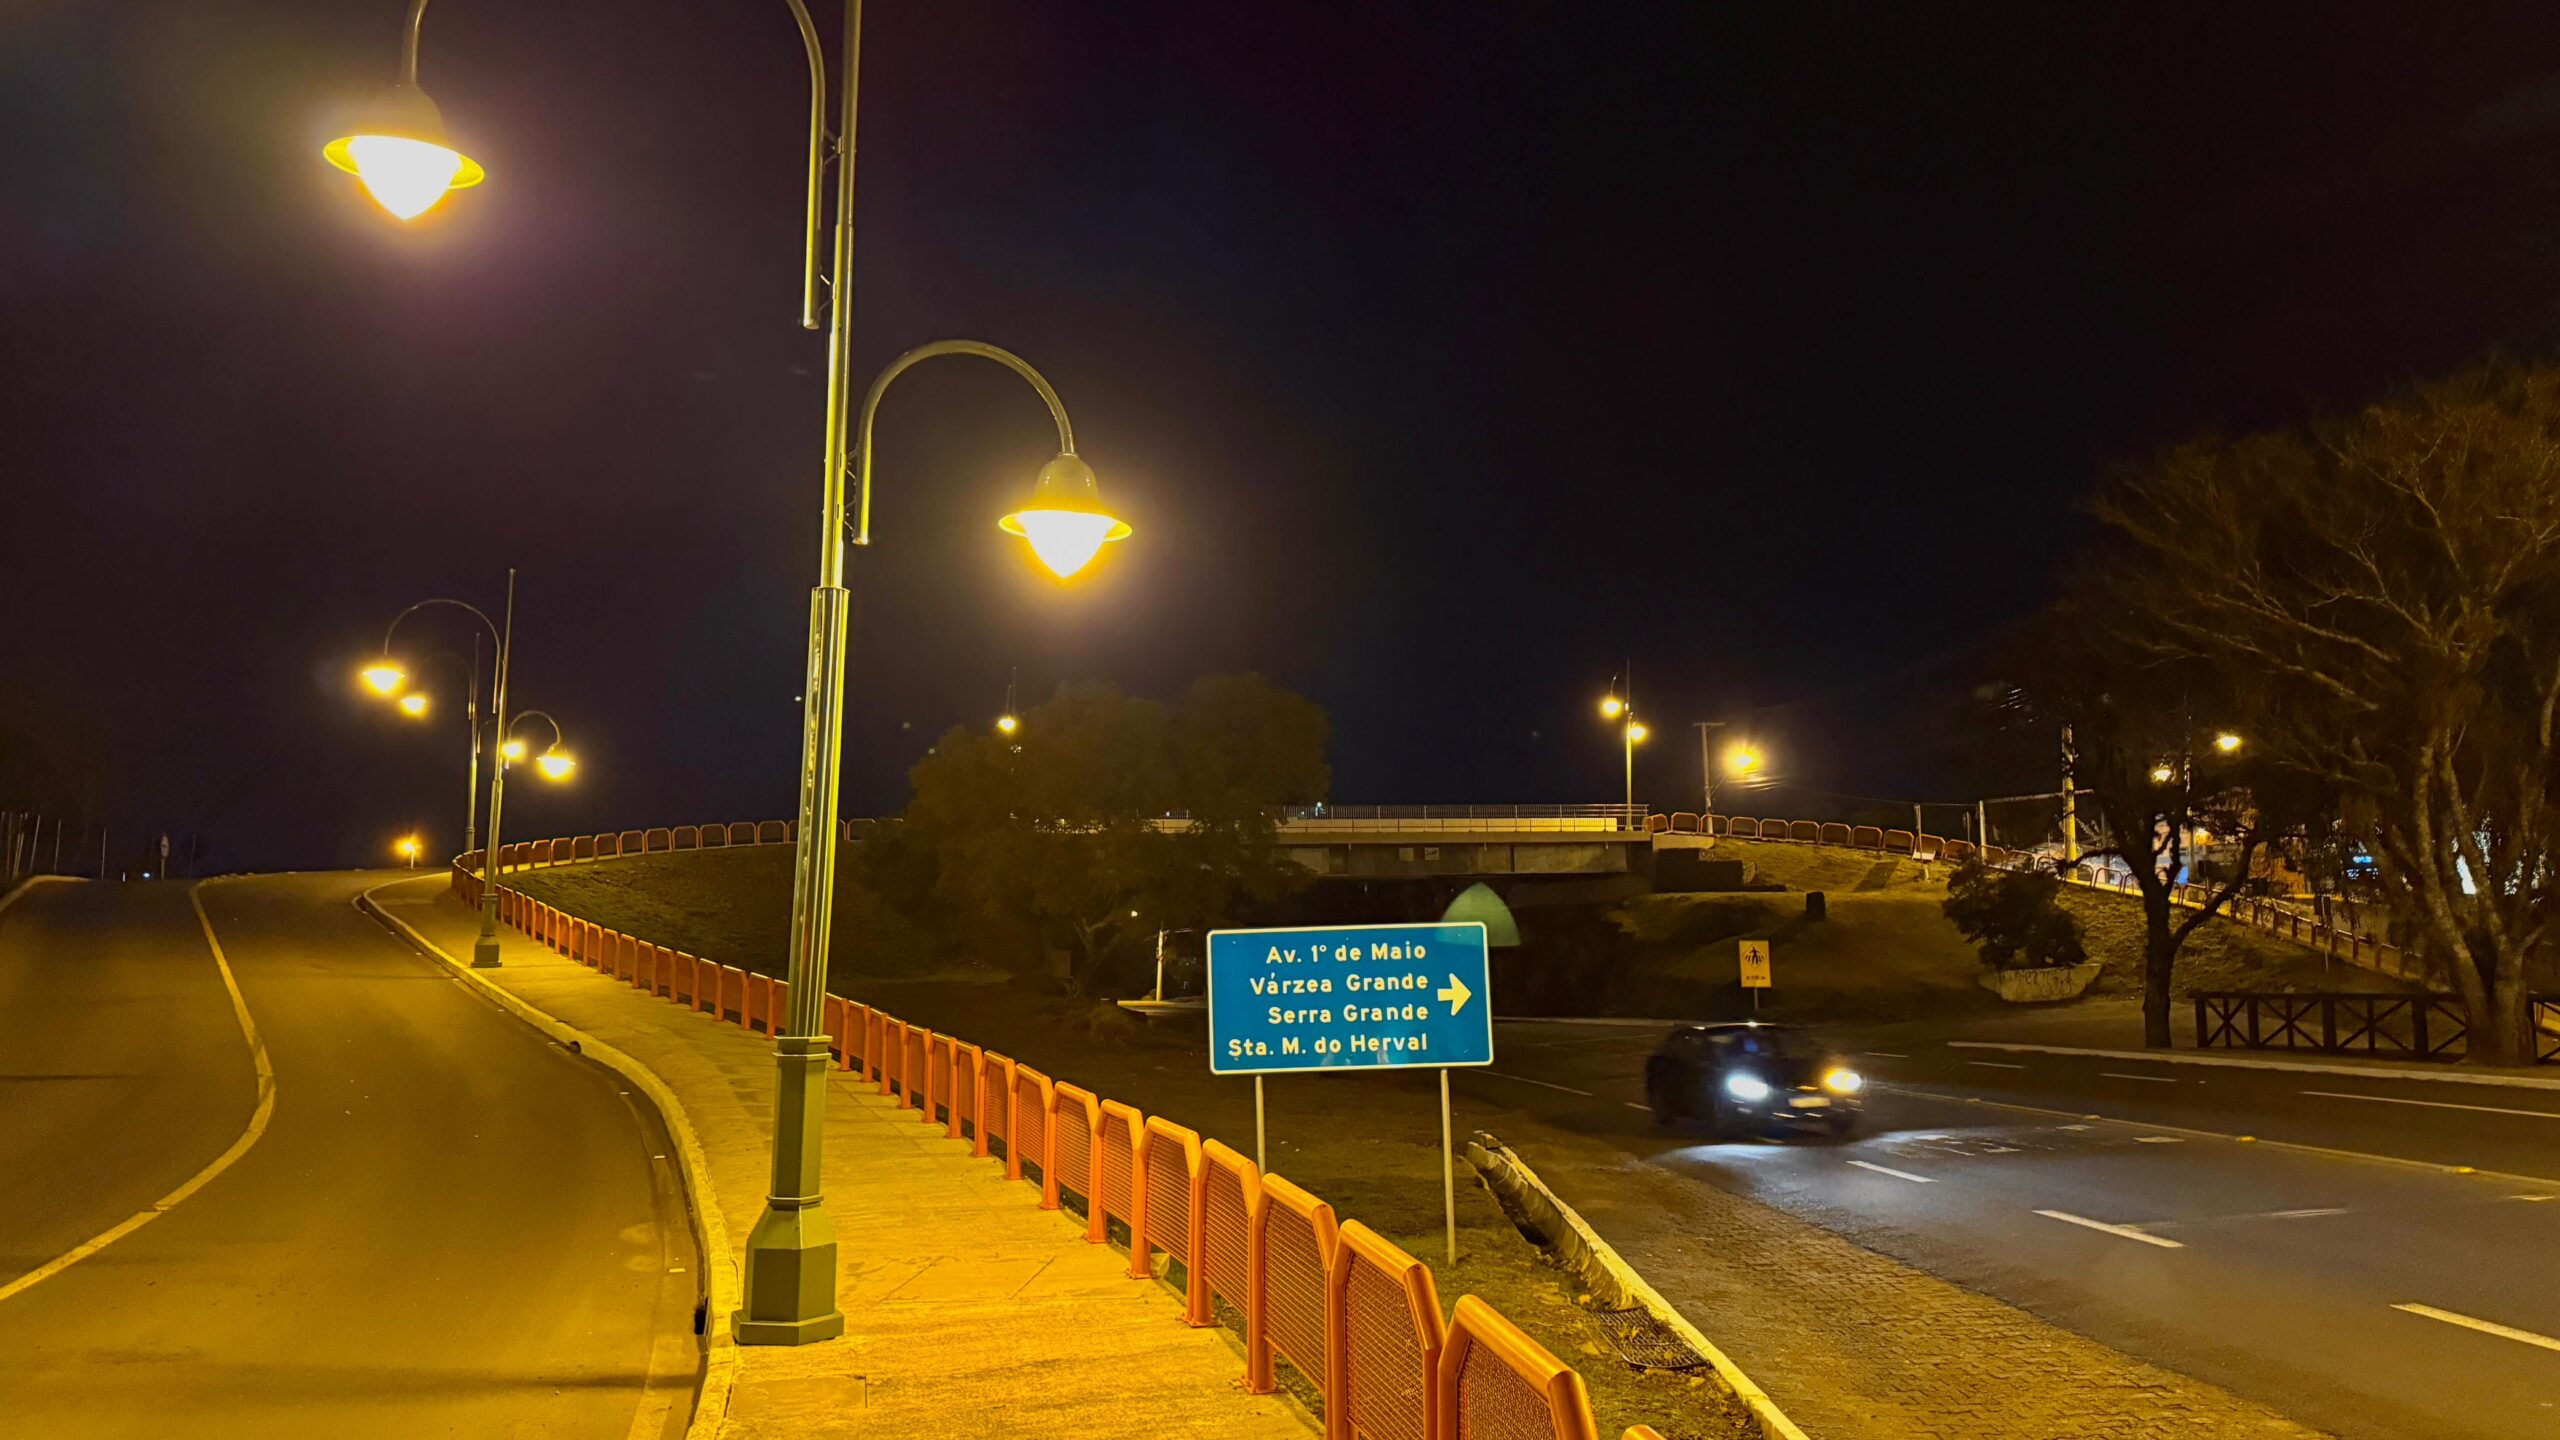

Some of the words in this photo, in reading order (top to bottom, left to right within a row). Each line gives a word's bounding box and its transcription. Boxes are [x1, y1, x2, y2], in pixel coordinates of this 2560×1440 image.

[1265, 946, 1302, 964] Av.
[1334, 944, 1362, 962] de
[1371, 941, 1426, 961] Maio
[1249, 972, 1332, 995] Várzea
[1346, 972, 1429, 992] Grande
[1268, 1006, 1332, 1025] Serra
[1343, 1003, 1429, 1022] Grande
[1228, 1038, 1274, 1057] Sta.
[1281, 1036, 1307, 1055] M.
[1314, 1036, 1342, 1054] do
[1350, 1032, 1427, 1053] Herval
